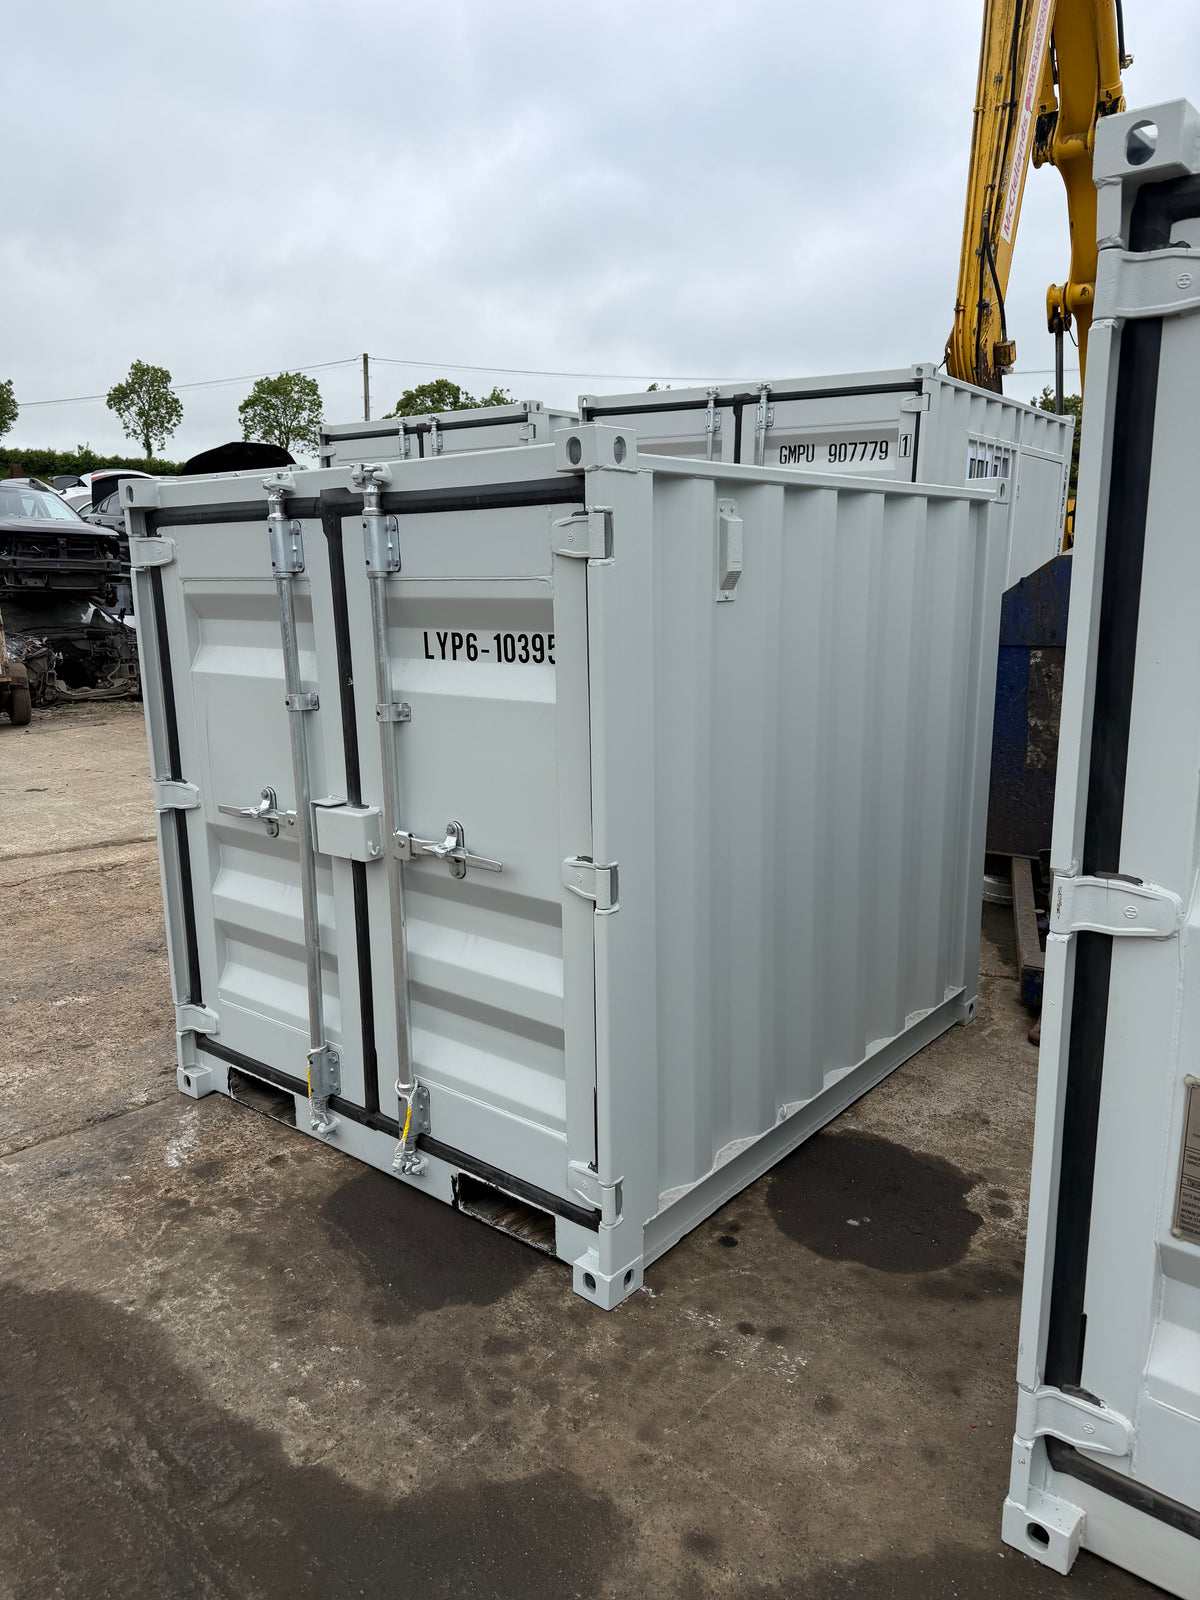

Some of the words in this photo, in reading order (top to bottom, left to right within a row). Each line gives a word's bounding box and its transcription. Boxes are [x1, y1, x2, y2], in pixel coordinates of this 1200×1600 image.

[1003, 115, 1028, 237] McClellands
[779, 443, 815, 465] GMPU
[828, 440, 889, 463] 907779
[901, 435, 910, 457] 1
[423, 631, 556, 665] LYP6-10395
